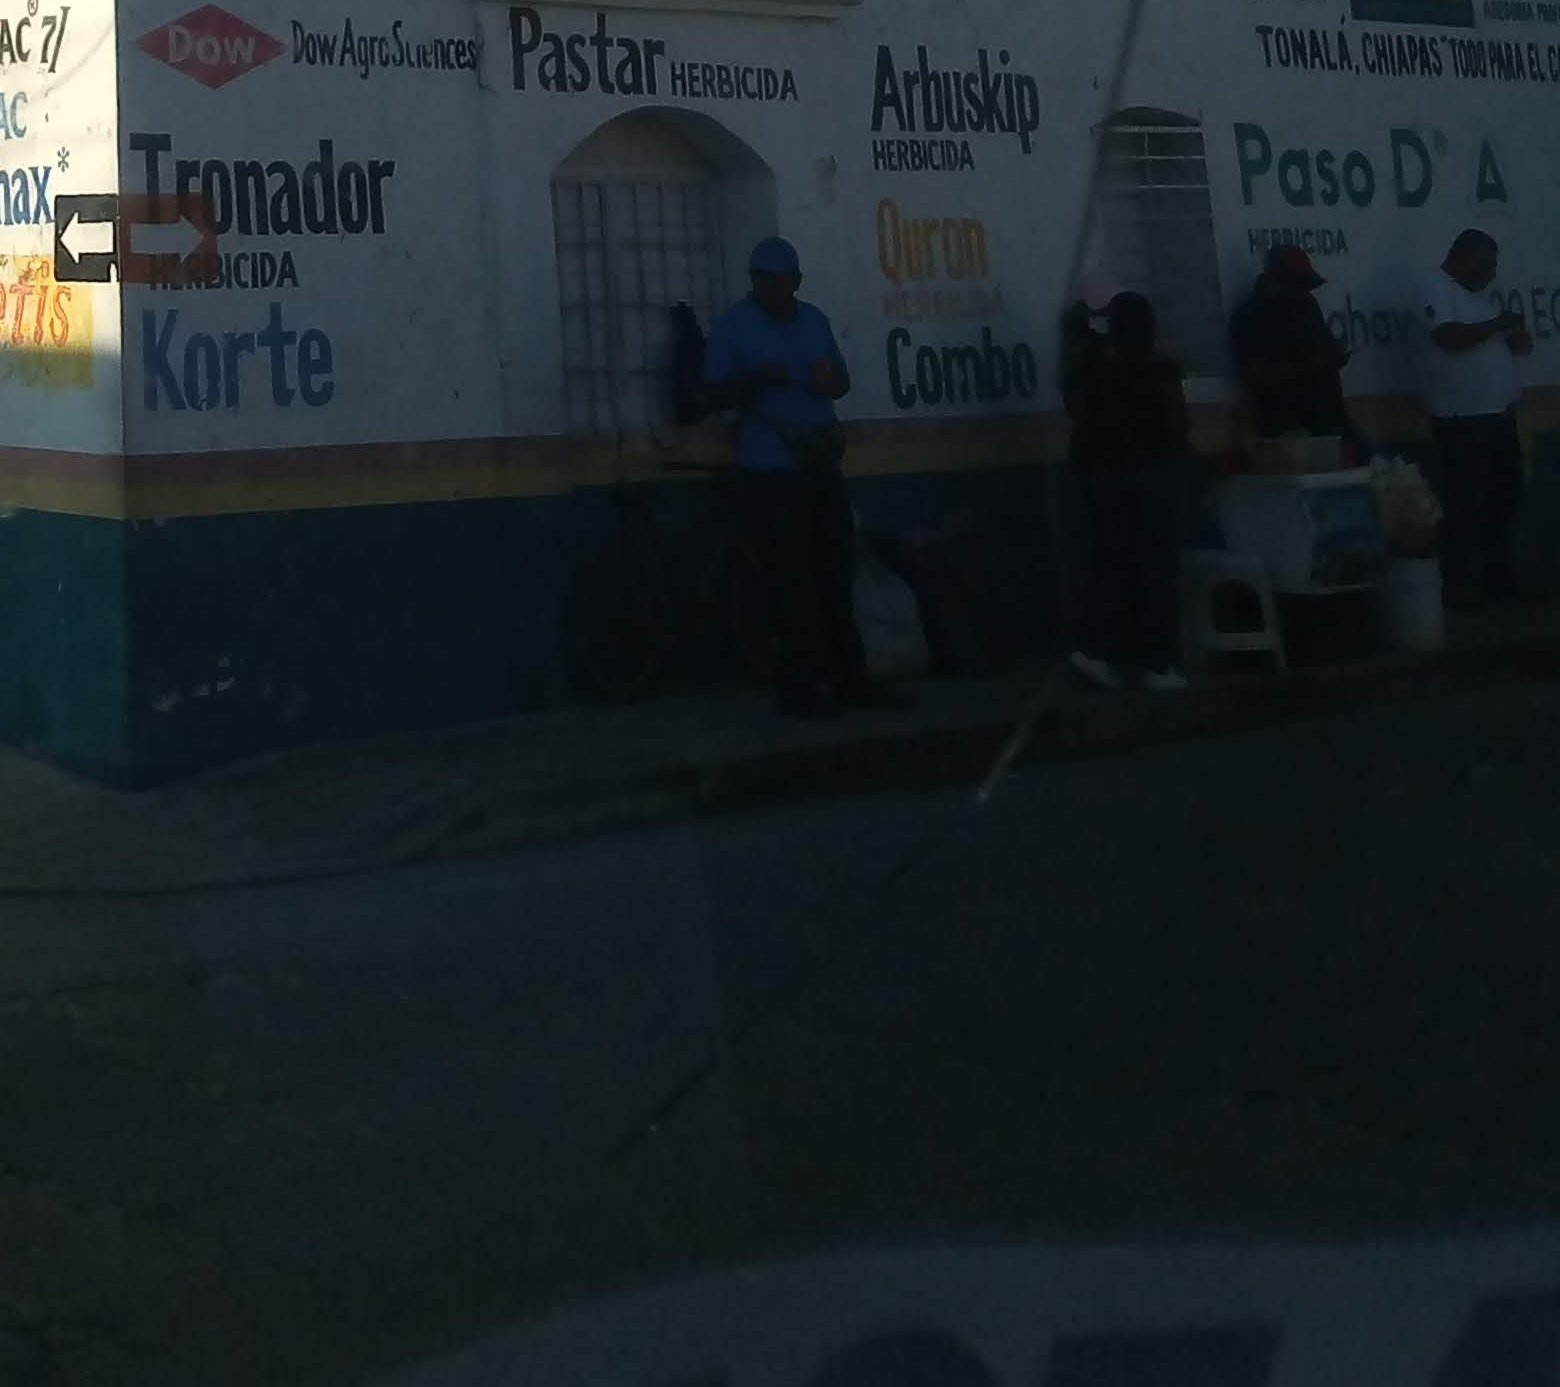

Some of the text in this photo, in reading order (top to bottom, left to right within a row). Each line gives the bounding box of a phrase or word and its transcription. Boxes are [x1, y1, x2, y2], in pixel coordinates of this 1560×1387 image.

[167, 25, 256, 65] Dow
[507, 5, 799, 102] Pastar HERBICIDA
[870, 44, 1040, 155] Arbuskip
[129, 133, 396, 235] Tronador
[872, 139, 976, 171] HERBICIDA
[1233, 122, 1376, 207] Paso
[142, 301, 335, 411] Korte
[886, 327, 1036, 408] Combo
